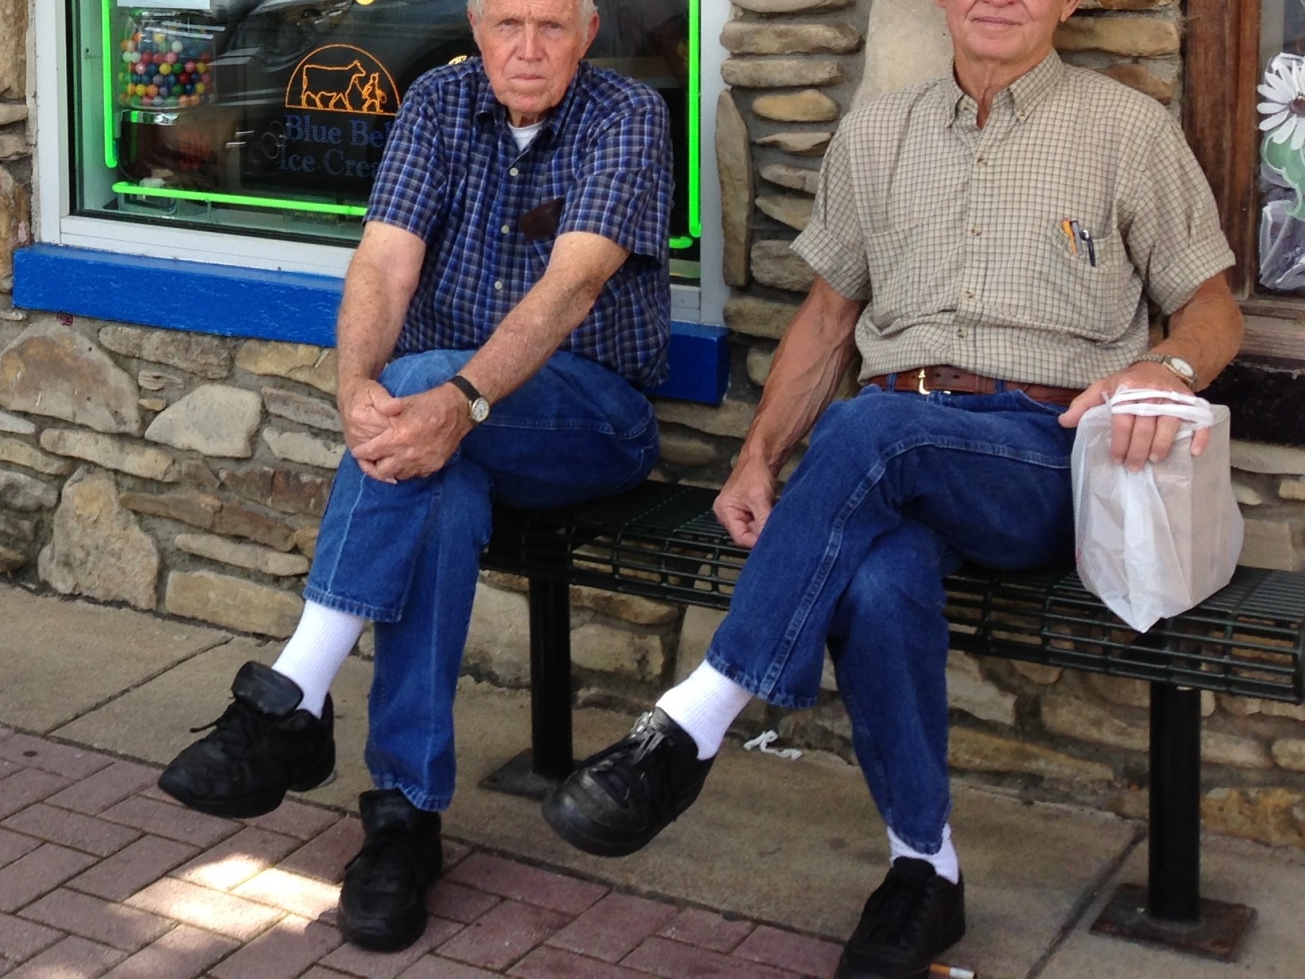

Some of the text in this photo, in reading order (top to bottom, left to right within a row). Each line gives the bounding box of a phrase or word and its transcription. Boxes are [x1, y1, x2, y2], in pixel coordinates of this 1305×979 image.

[285, 114, 393, 147] Blue Bel
[278, 145, 316, 172] Ice
